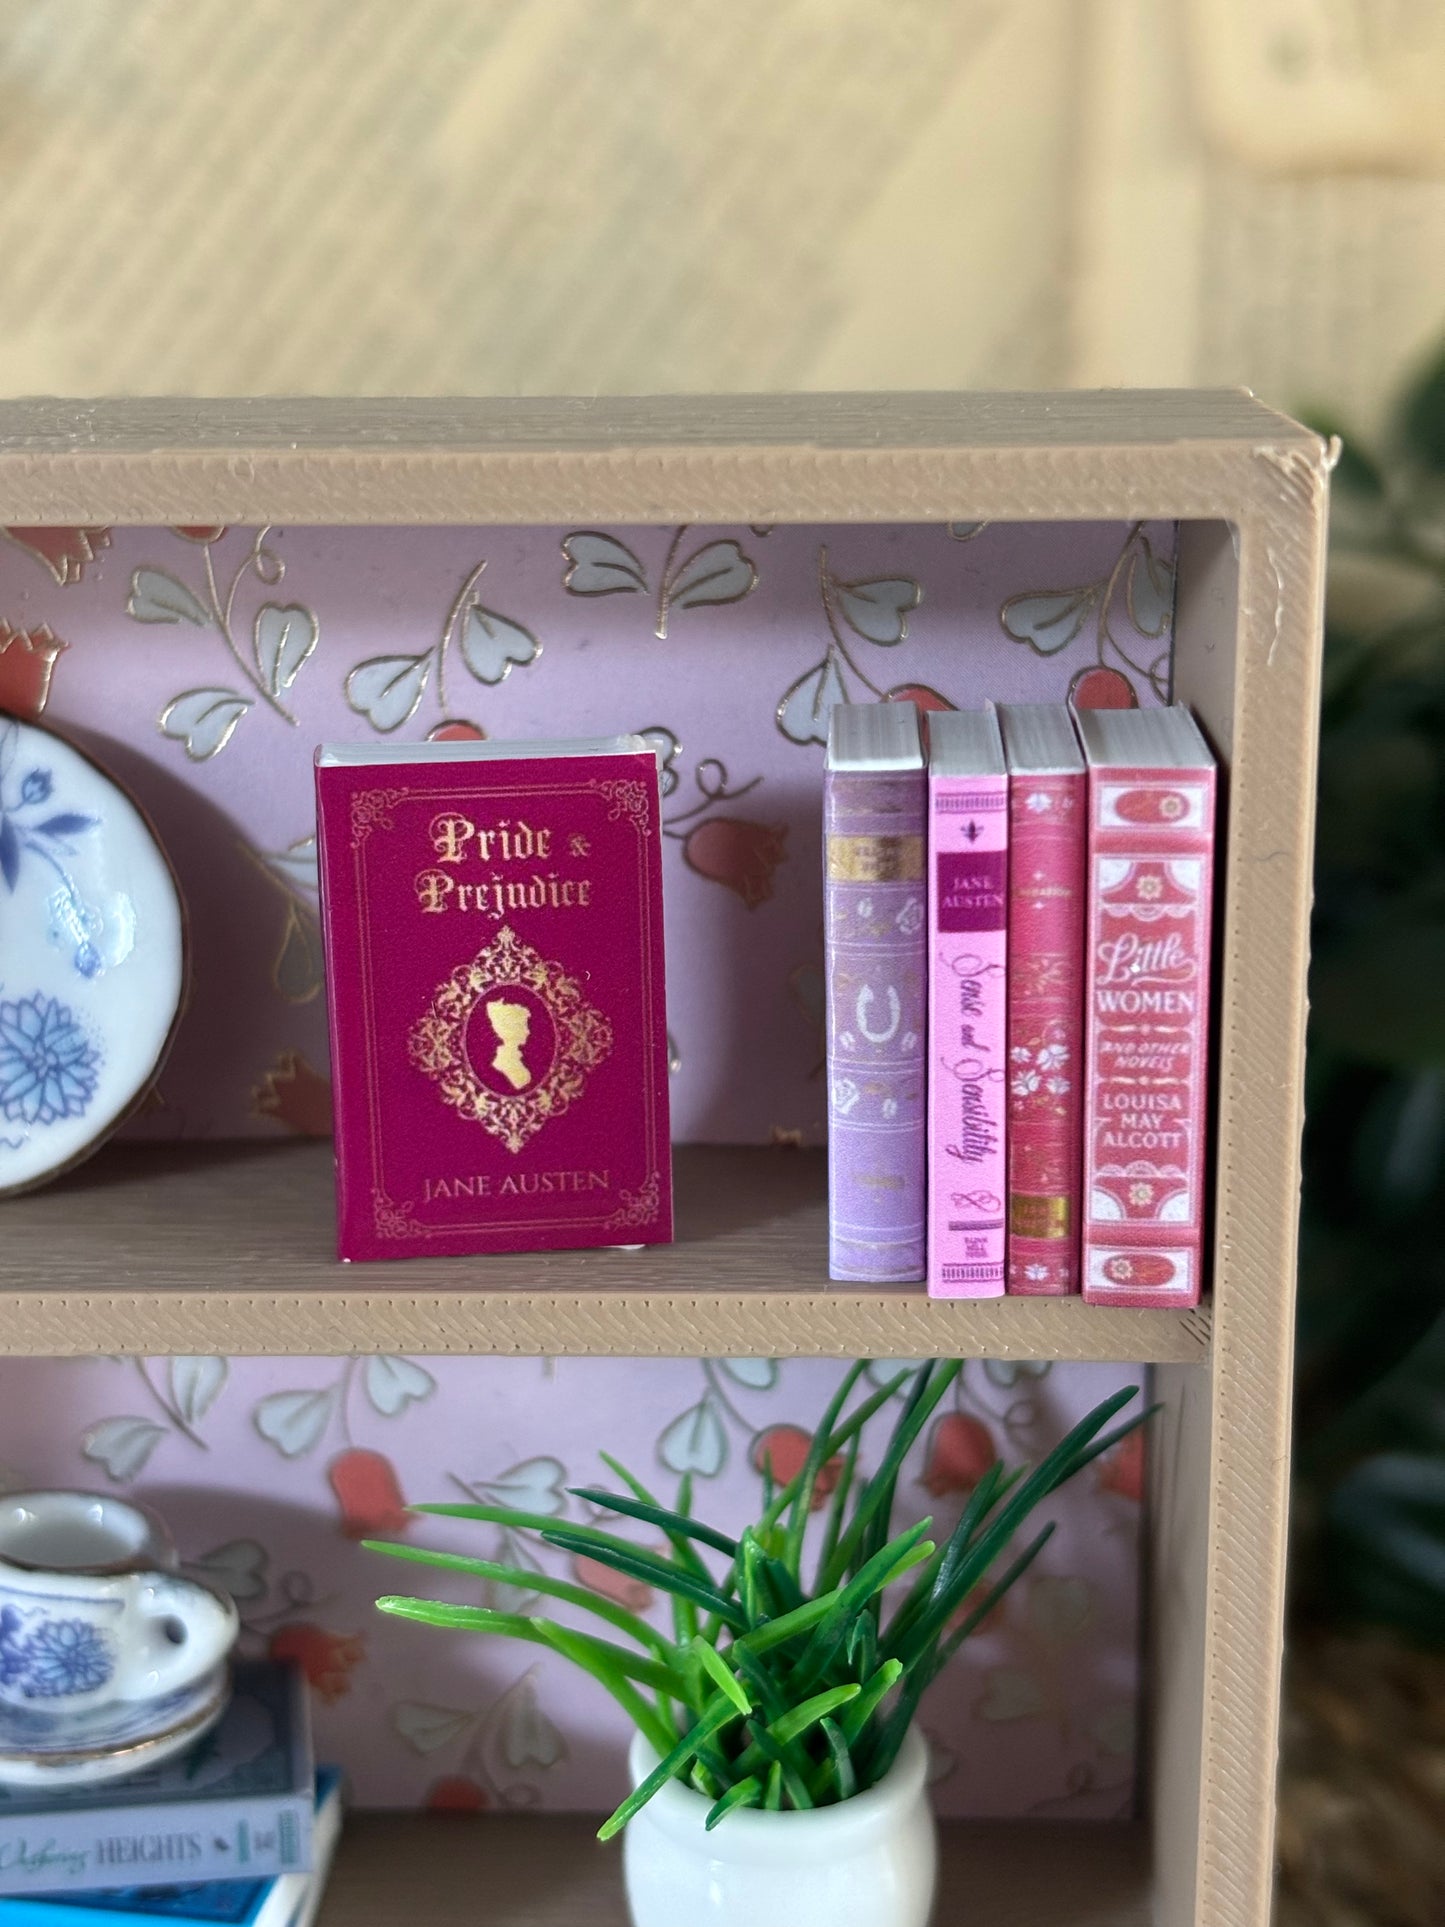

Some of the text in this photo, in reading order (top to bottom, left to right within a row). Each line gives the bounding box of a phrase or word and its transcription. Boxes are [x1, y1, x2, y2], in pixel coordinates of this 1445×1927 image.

[429, 811, 591, 863] Pride &
[414, 868, 592, 920] Prejudice
[954, 876, 994, 892] JANE
[942, 893, 1004, 909] AUSTEN
[1097, 932, 1196, 986] Little
[939, 952, 1005, 1017] Sense
[1096, 990, 1195, 1014] WOMEN
[960, 1024, 991, 1052] and
[941, 1056, 1005, 1164] Sensibility
[1103, 1093, 1182, 1110] LOUISA
[1120, 1112, 1163, 1130] MAY
[1103, 1131, 1182, 1149] ALCOTT
[423, 1169, 610, 1204] JANE AUSTEN
[96, 1832, 203, 1866] HEIGHTS
